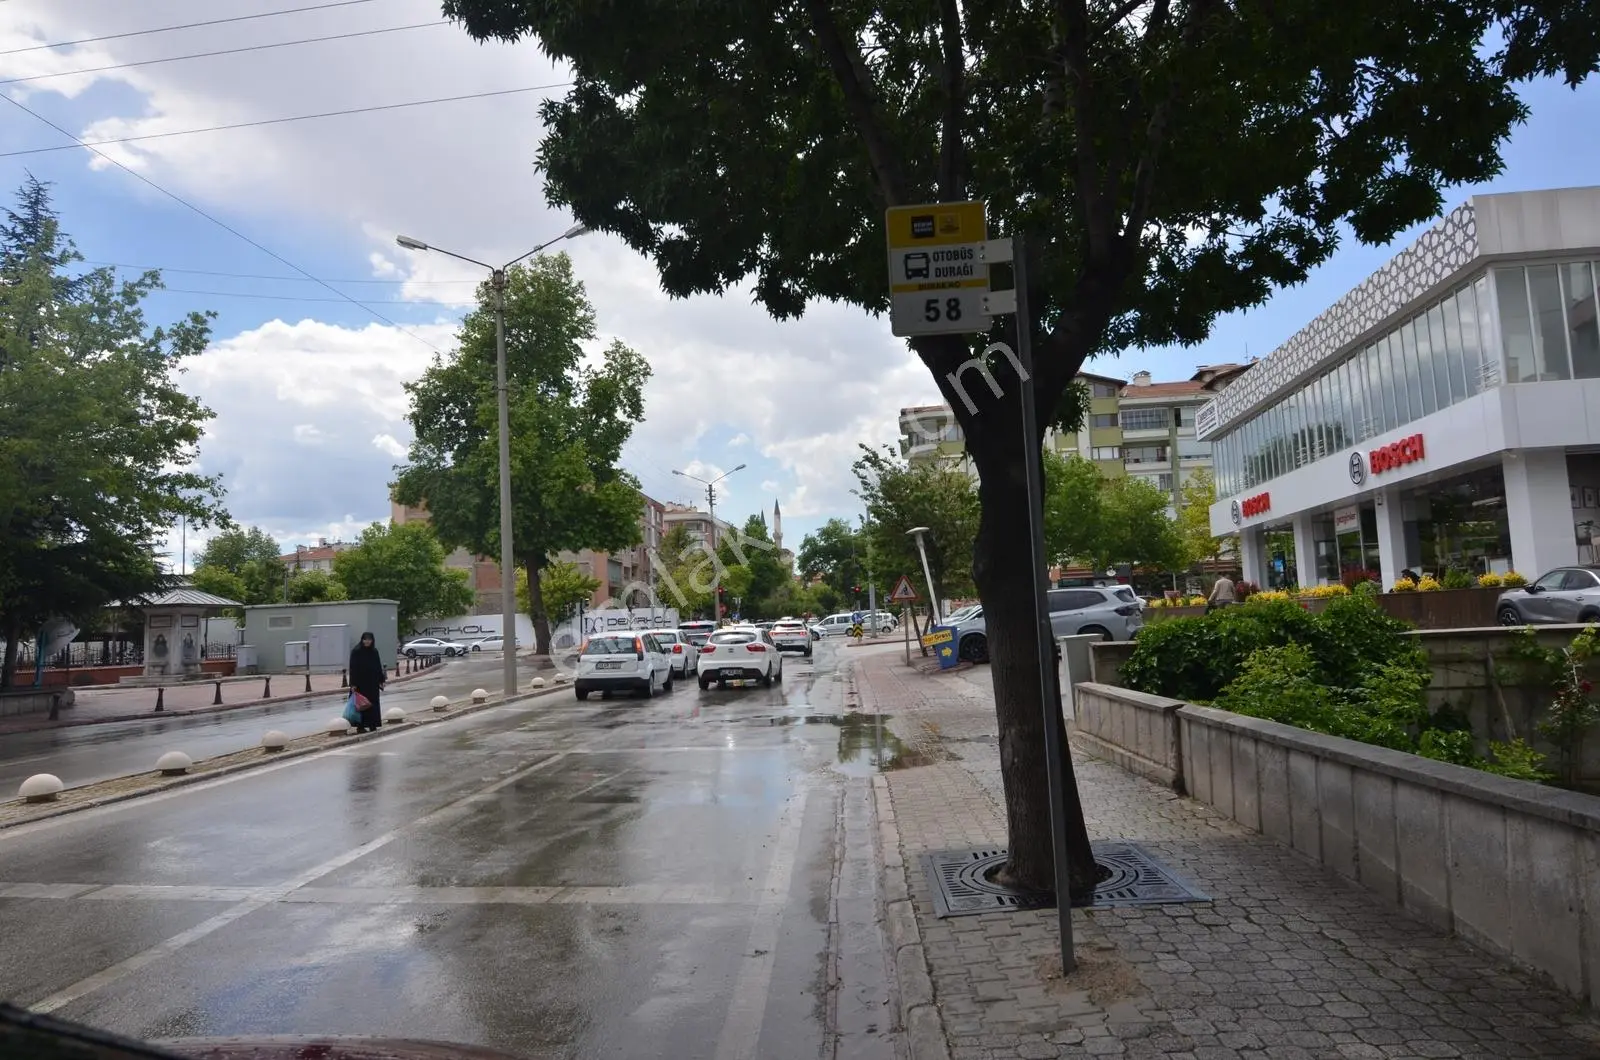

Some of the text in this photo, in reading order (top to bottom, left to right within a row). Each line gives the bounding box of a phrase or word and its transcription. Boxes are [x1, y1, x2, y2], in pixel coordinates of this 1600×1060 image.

[932, 247, 974, 263] OTOBÜS
[935, 263, 973, 278] DURAĞI
[925, 298, 962, 322] 58
[1369, 433, 1425, 475] BOSCH
[1242, 491, 1271, 519] BOSCH
